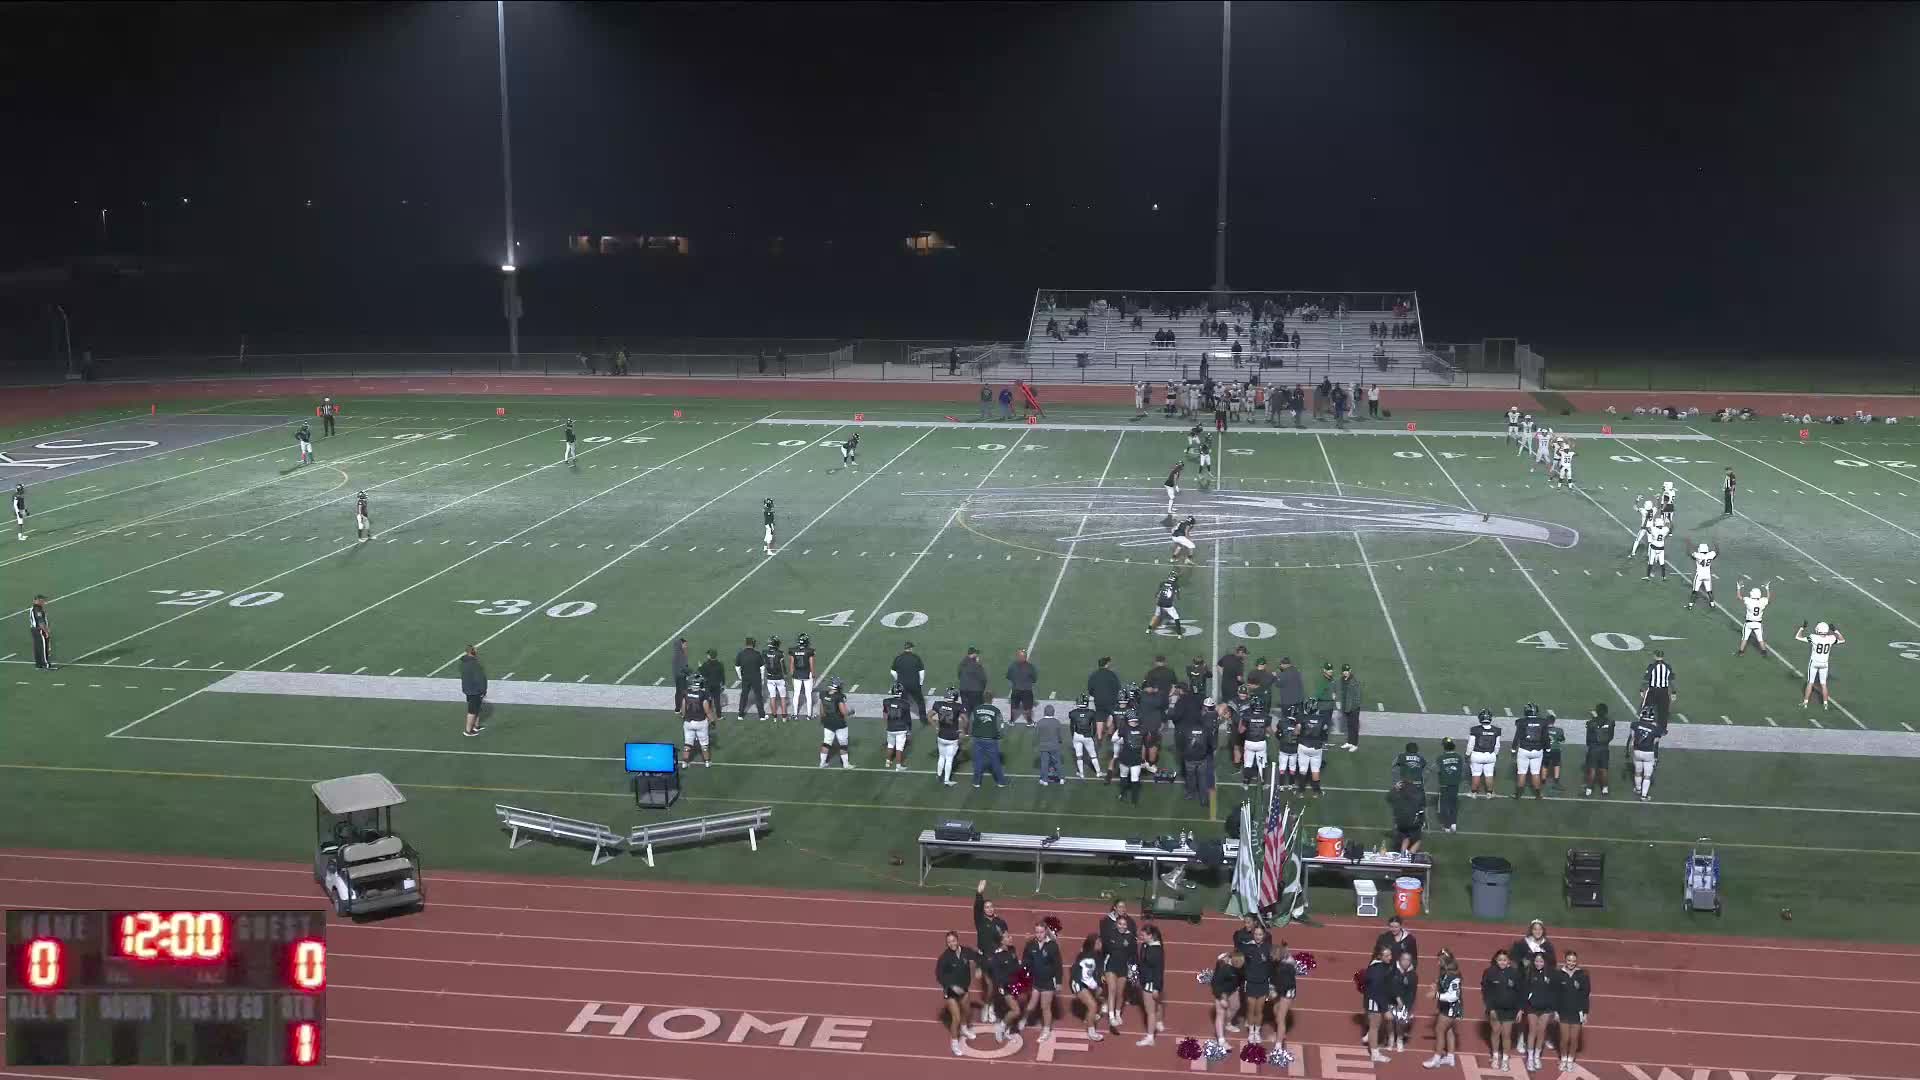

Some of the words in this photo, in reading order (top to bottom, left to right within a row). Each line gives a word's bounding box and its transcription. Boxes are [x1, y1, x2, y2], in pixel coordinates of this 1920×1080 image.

[474, 599, 598, 618] 30
[1753, 607, 1760, 616] 9
[807, 609, 929, 628] 40
[1515, 630, 1645, 651] 40
[1816, 643, 1830, 655] 80
[566, 1002, 873, 1051] HOME
[958, 1025, 1090, 1062] OF
